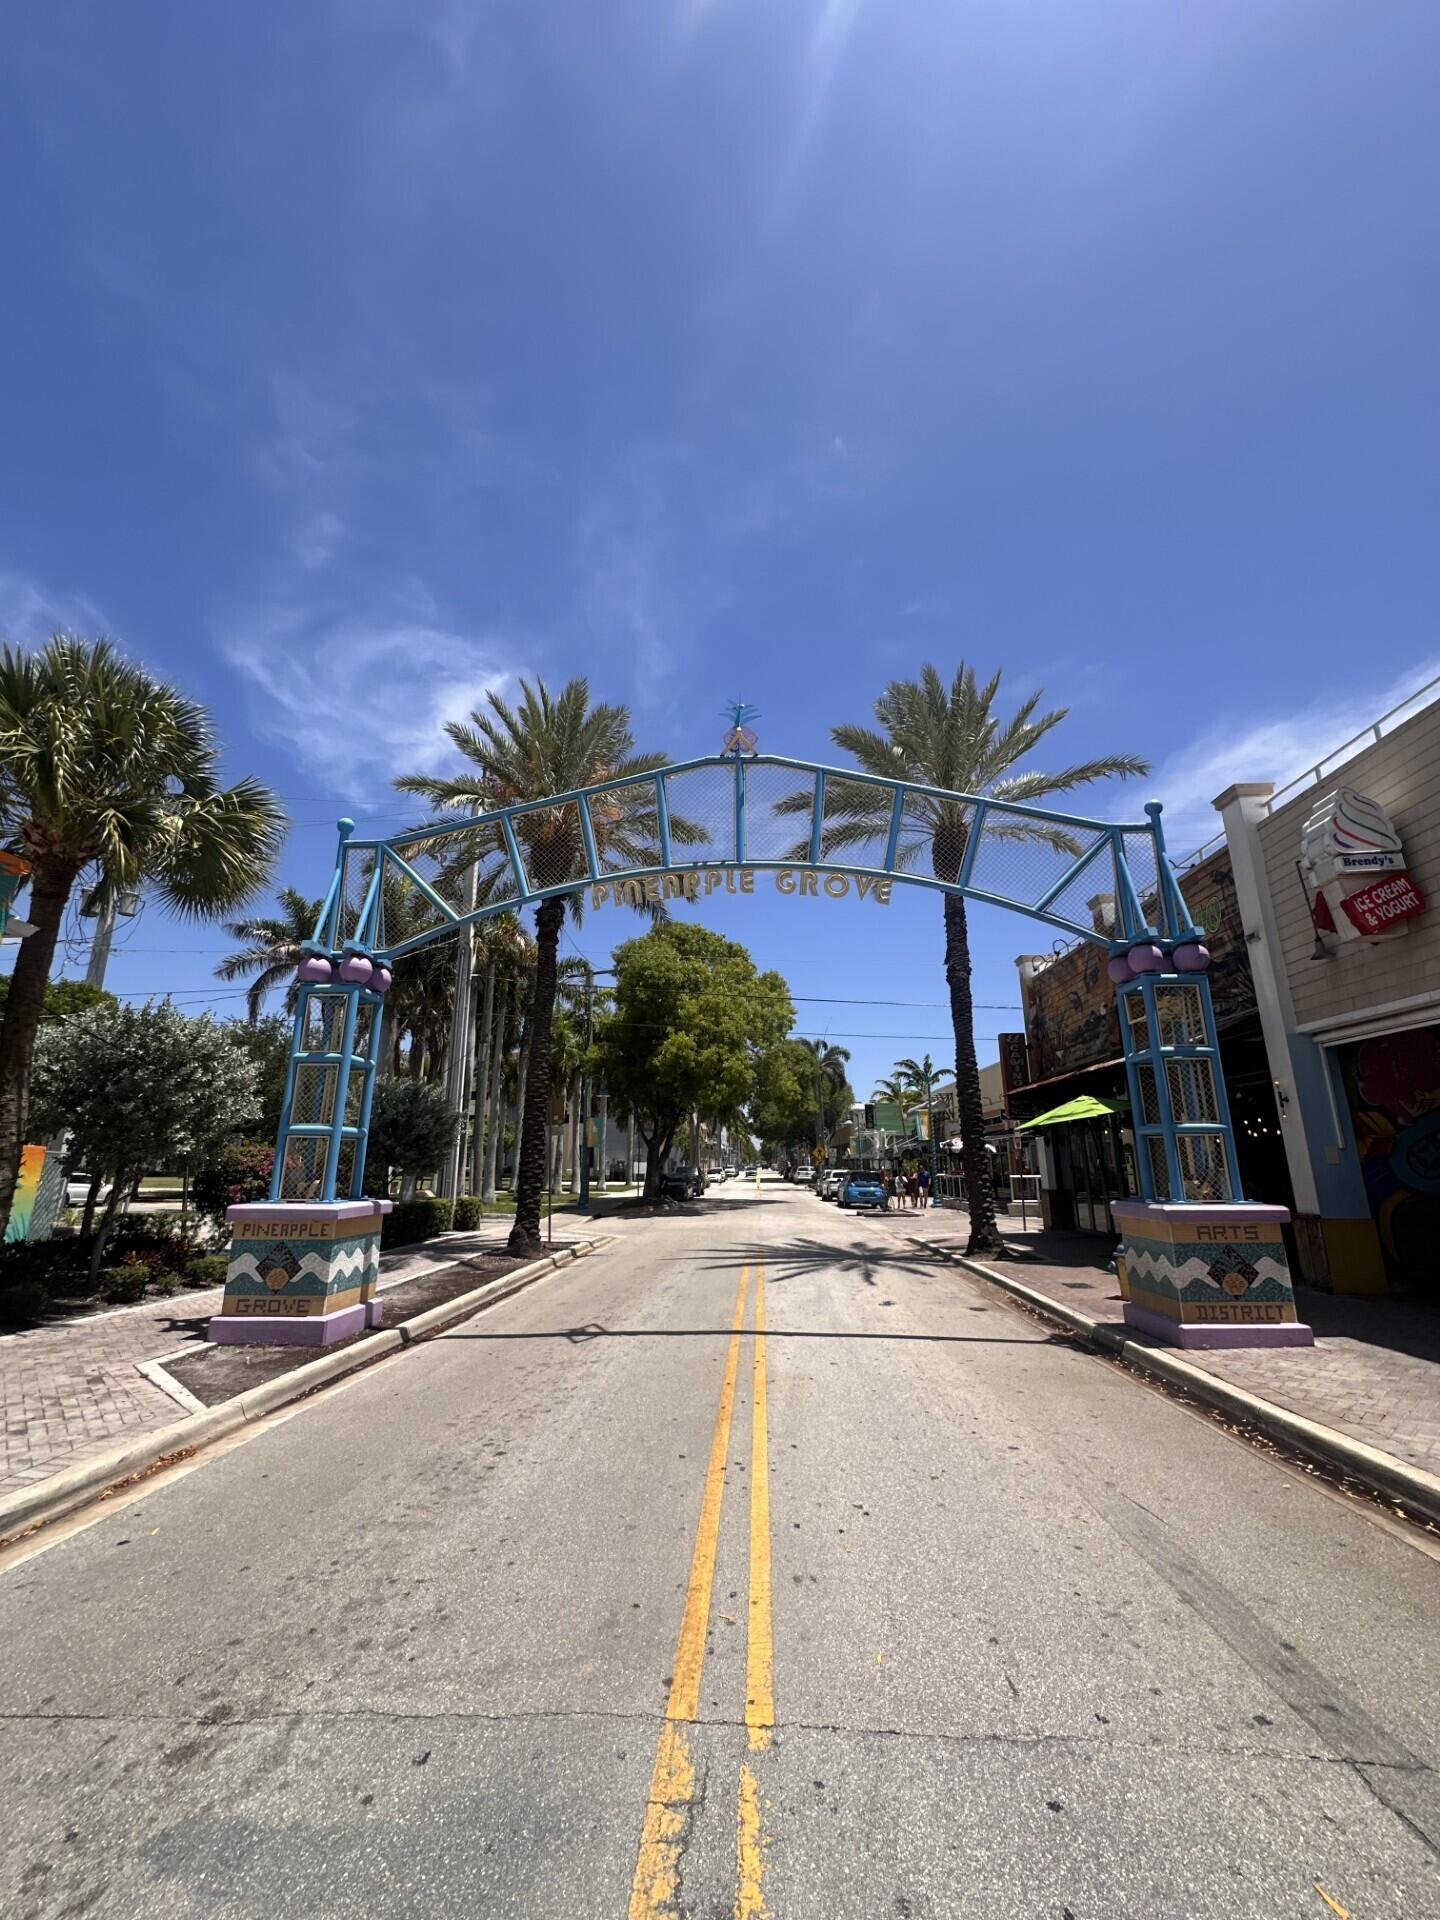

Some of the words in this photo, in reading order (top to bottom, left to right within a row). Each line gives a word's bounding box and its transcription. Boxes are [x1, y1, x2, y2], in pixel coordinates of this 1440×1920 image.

[1343, 855, 1394, 867] Brendy's
[592, 869, 755, 911] PINEAPPLE
[776, 870, 895, 905] GROVE
[1353, 895, 1374, 913] ICE
[1371, 878, 1411, 904] CREAM
[1365, 912, 1378, 926] &
[1375, 891, 1420, 920] YOGURT
[242, 1223, 330, 1237] PINEAPPLE
[1196, 1225, 1260, 1241] ARTS
[235, 1299, 311, 1314] GROVE
[1195, 1304, 1285, 1321] DISTRICT
